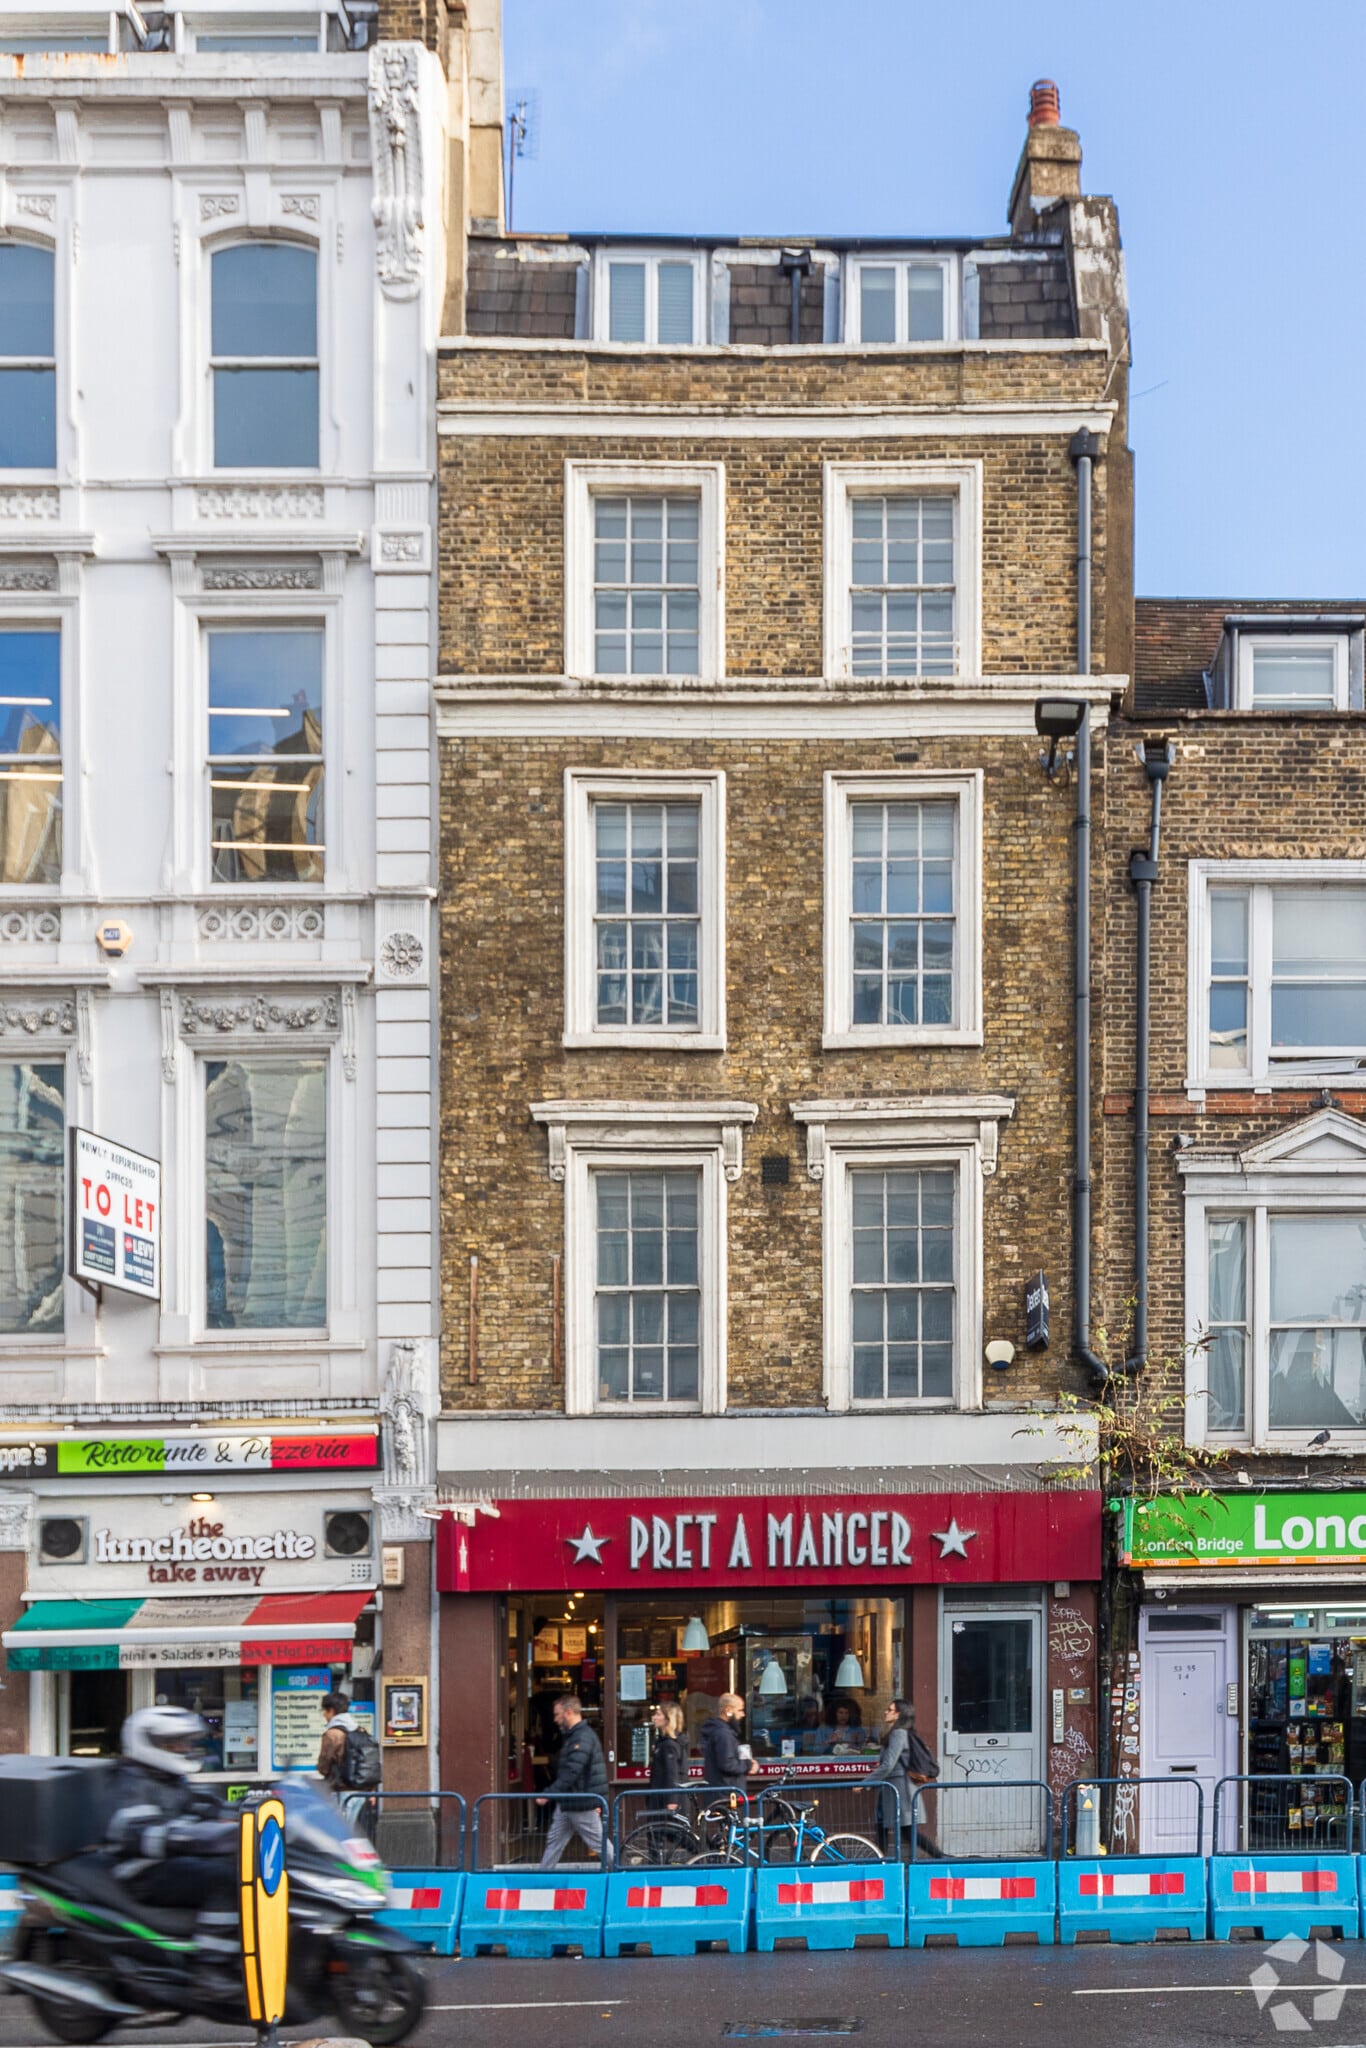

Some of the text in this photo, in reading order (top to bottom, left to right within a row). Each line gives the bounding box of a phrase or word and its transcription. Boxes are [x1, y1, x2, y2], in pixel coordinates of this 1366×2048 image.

[82, 1177, 155, 1234] TO LET
[83, 1438, 350, 1467] Ristorante & Pizzeria
[189, 1517, 224, 1538] the
[630, 1511, 912, 1569] PRET A MANGER
[95, 1528, 316, 1562] luncheonette
[1197, 1537, 1244, 1554] Bridge
[148, 1562, 265, 1586] take away
[104, 1649, 147, 1663] Panini
[160, 1649, 203, 1661] Salads
